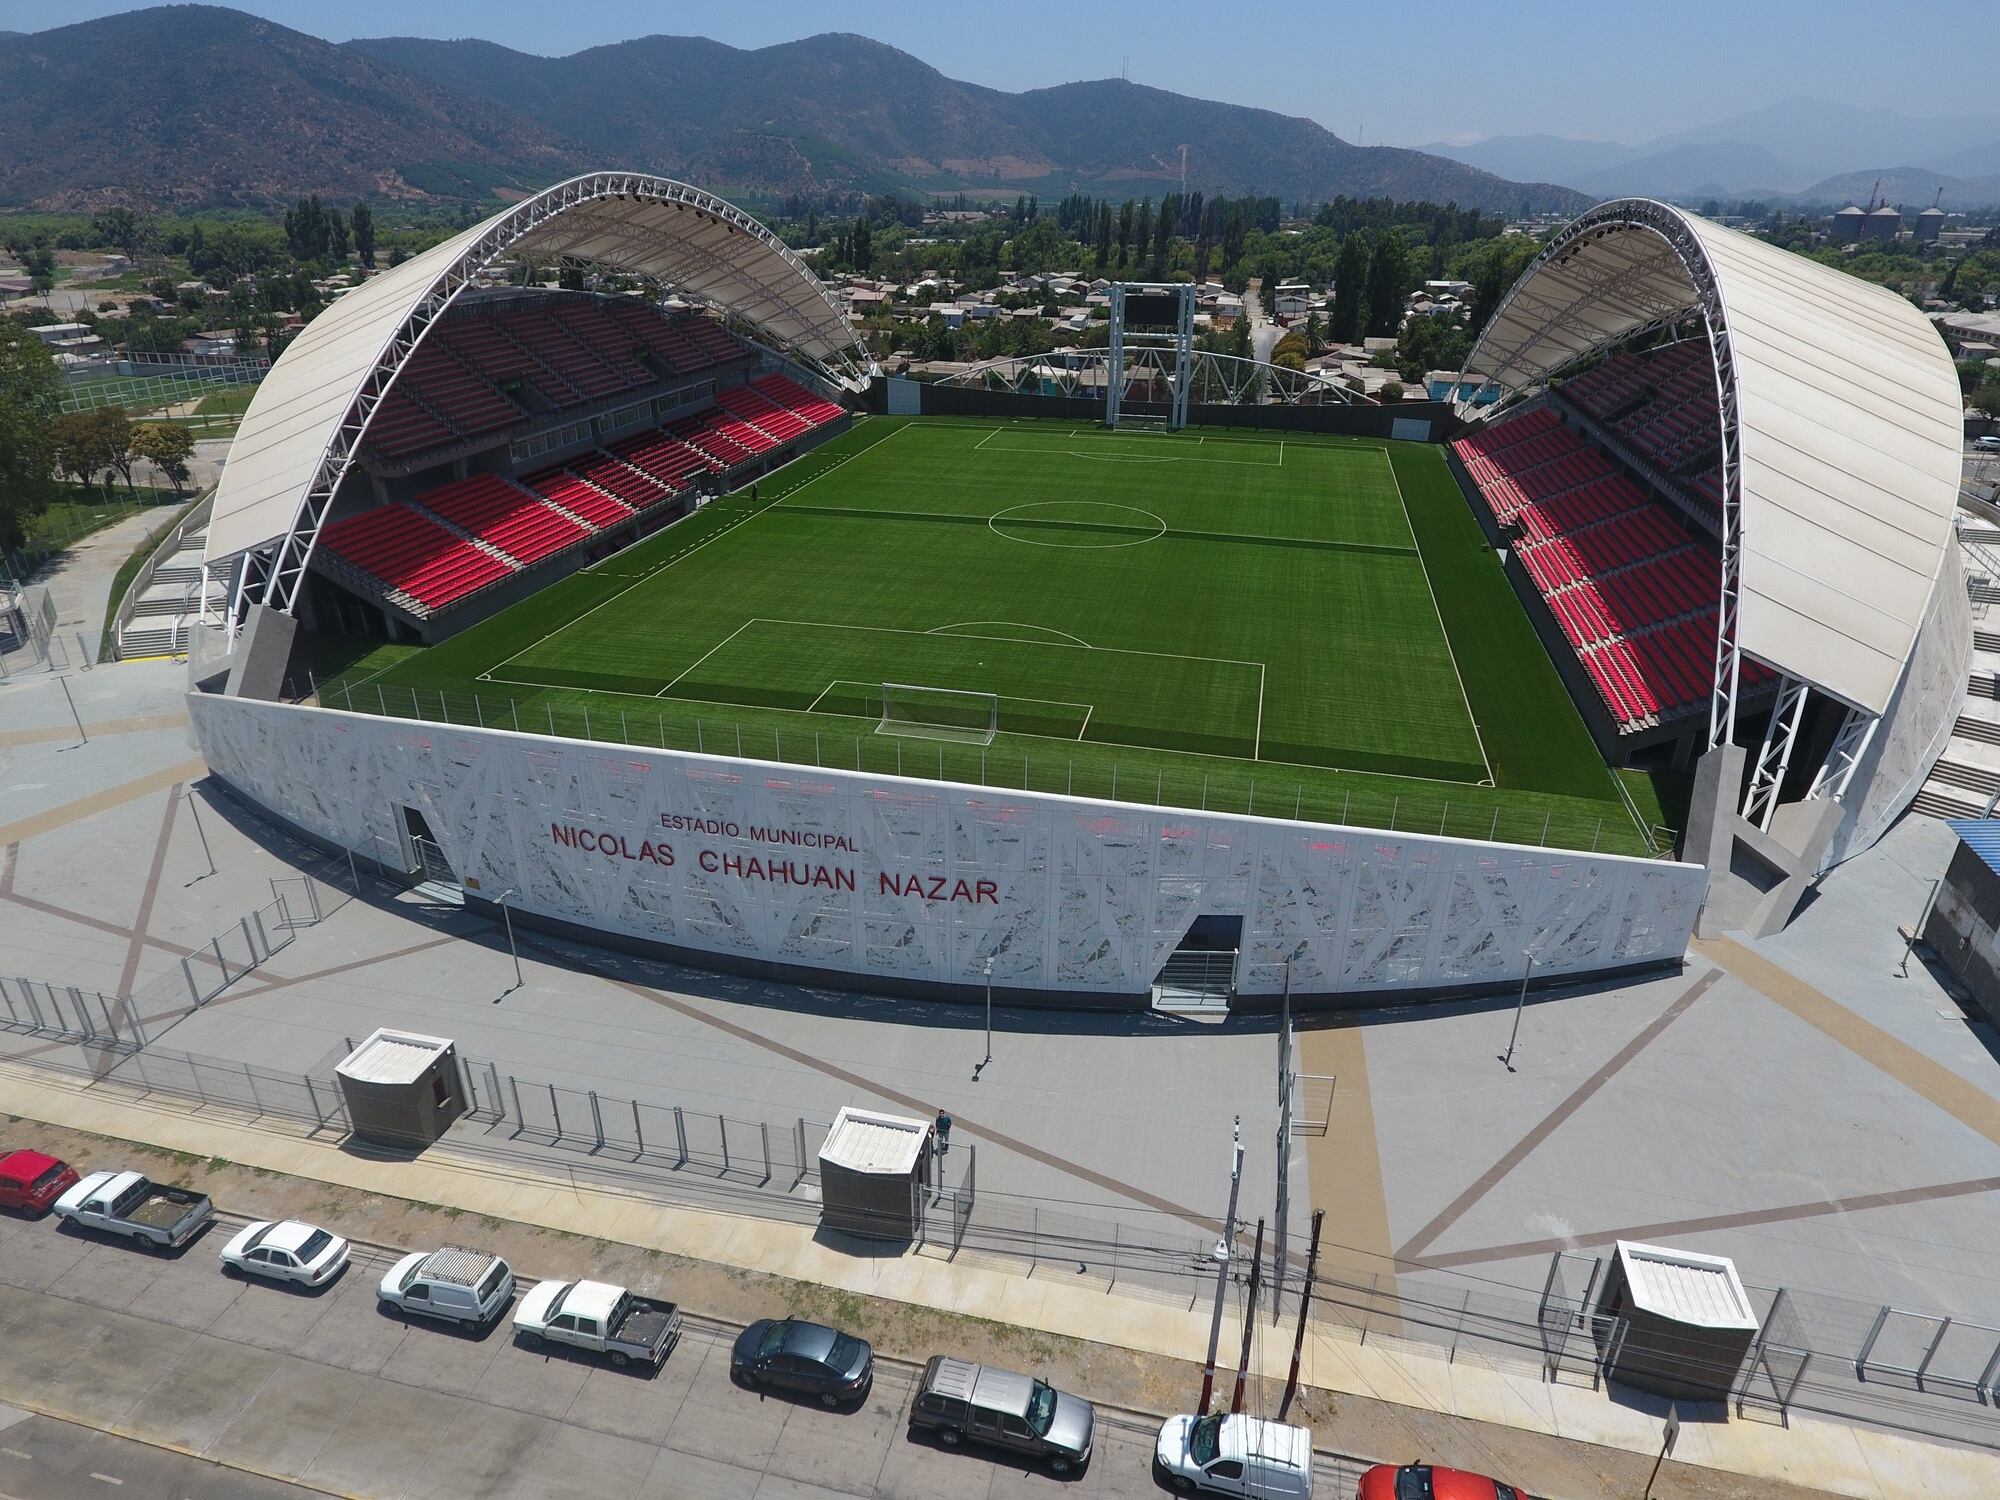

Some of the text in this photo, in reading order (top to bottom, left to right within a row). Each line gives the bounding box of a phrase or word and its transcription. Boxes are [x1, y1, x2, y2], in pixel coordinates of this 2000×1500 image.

[551, 823, 1000, 905] NICOLAS CHAHUAN NAZAR
[660, 813, 860, 854] ESTADIO MUNICIPAL
